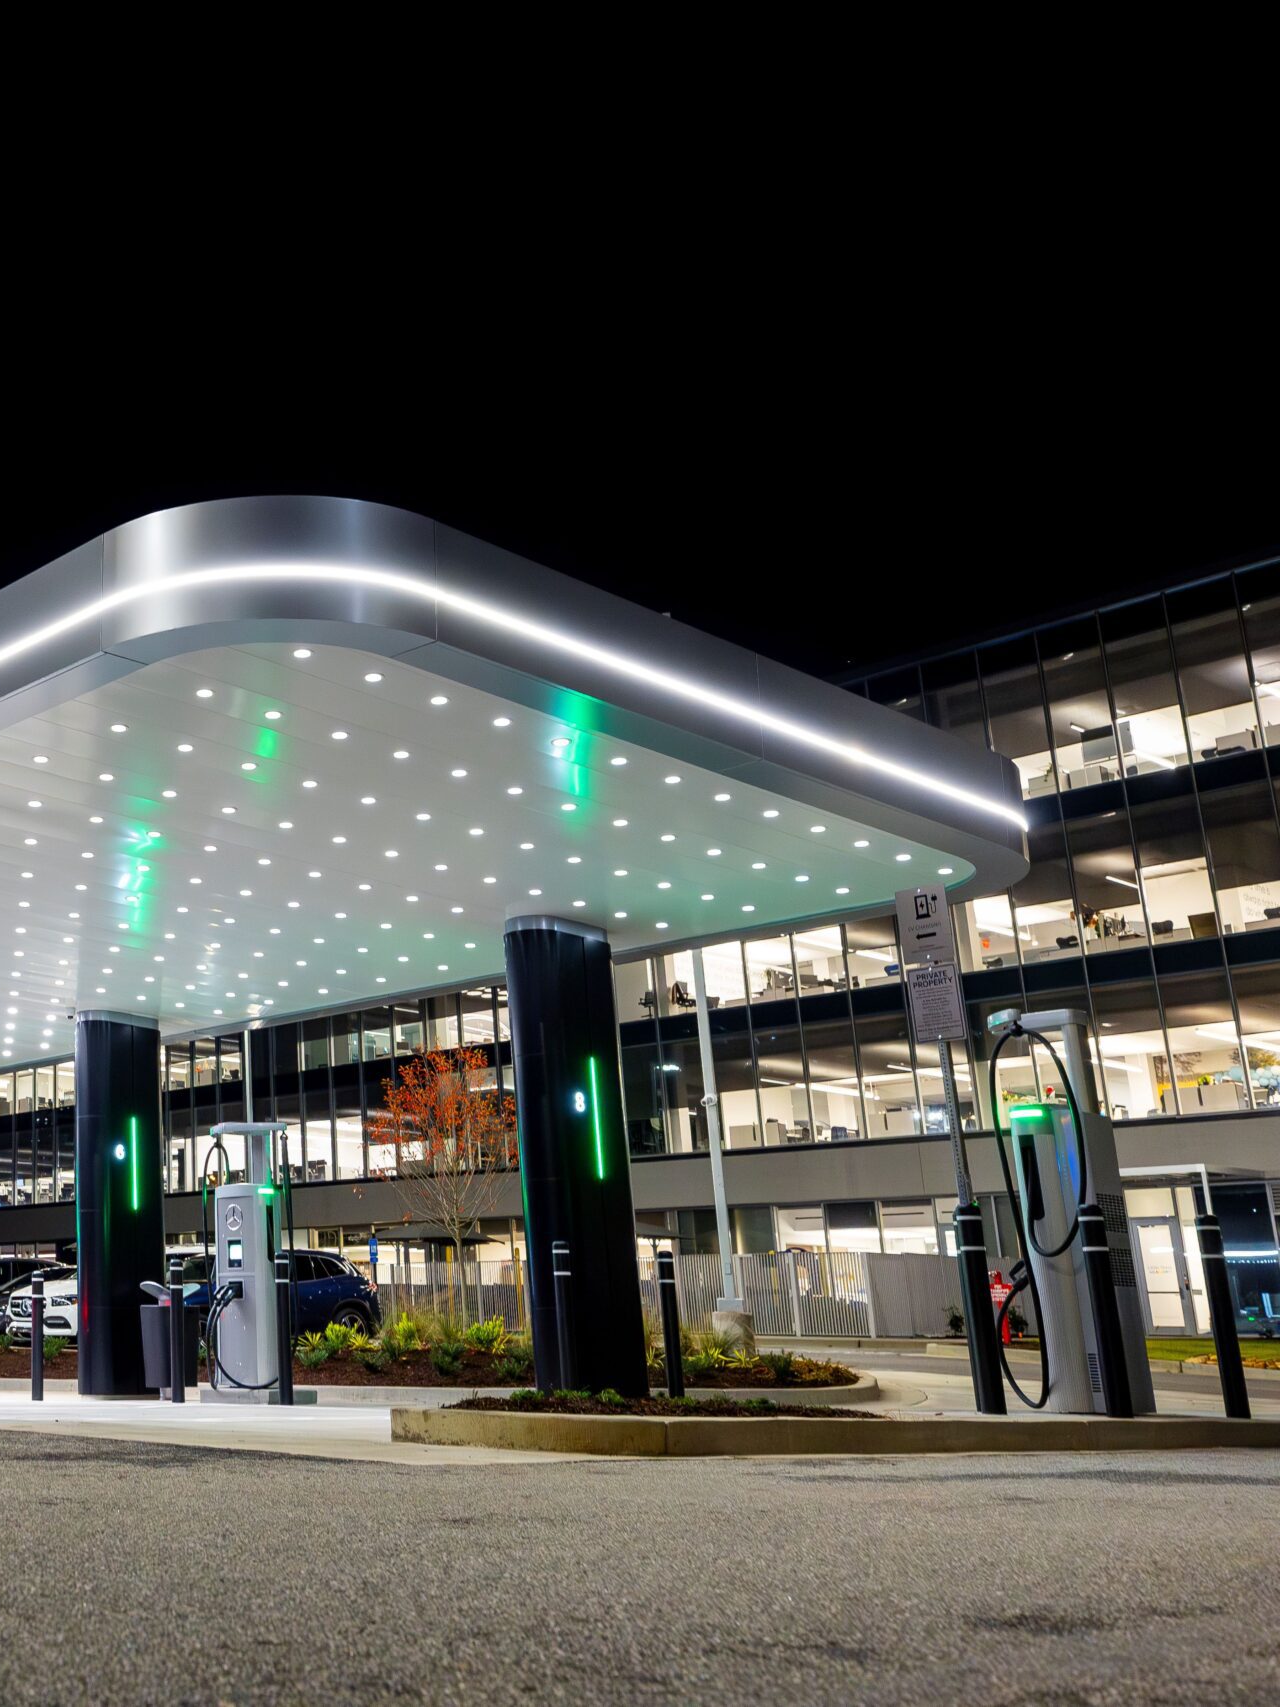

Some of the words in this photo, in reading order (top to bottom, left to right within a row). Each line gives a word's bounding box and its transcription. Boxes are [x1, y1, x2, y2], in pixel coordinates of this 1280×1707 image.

[913, 976, 952, 989] PROPERTY
[916, 970, 947, 981] PRIVATE
[575, 1091, 586, 1112] 8
[115, 1143, 125, 1160] 6
